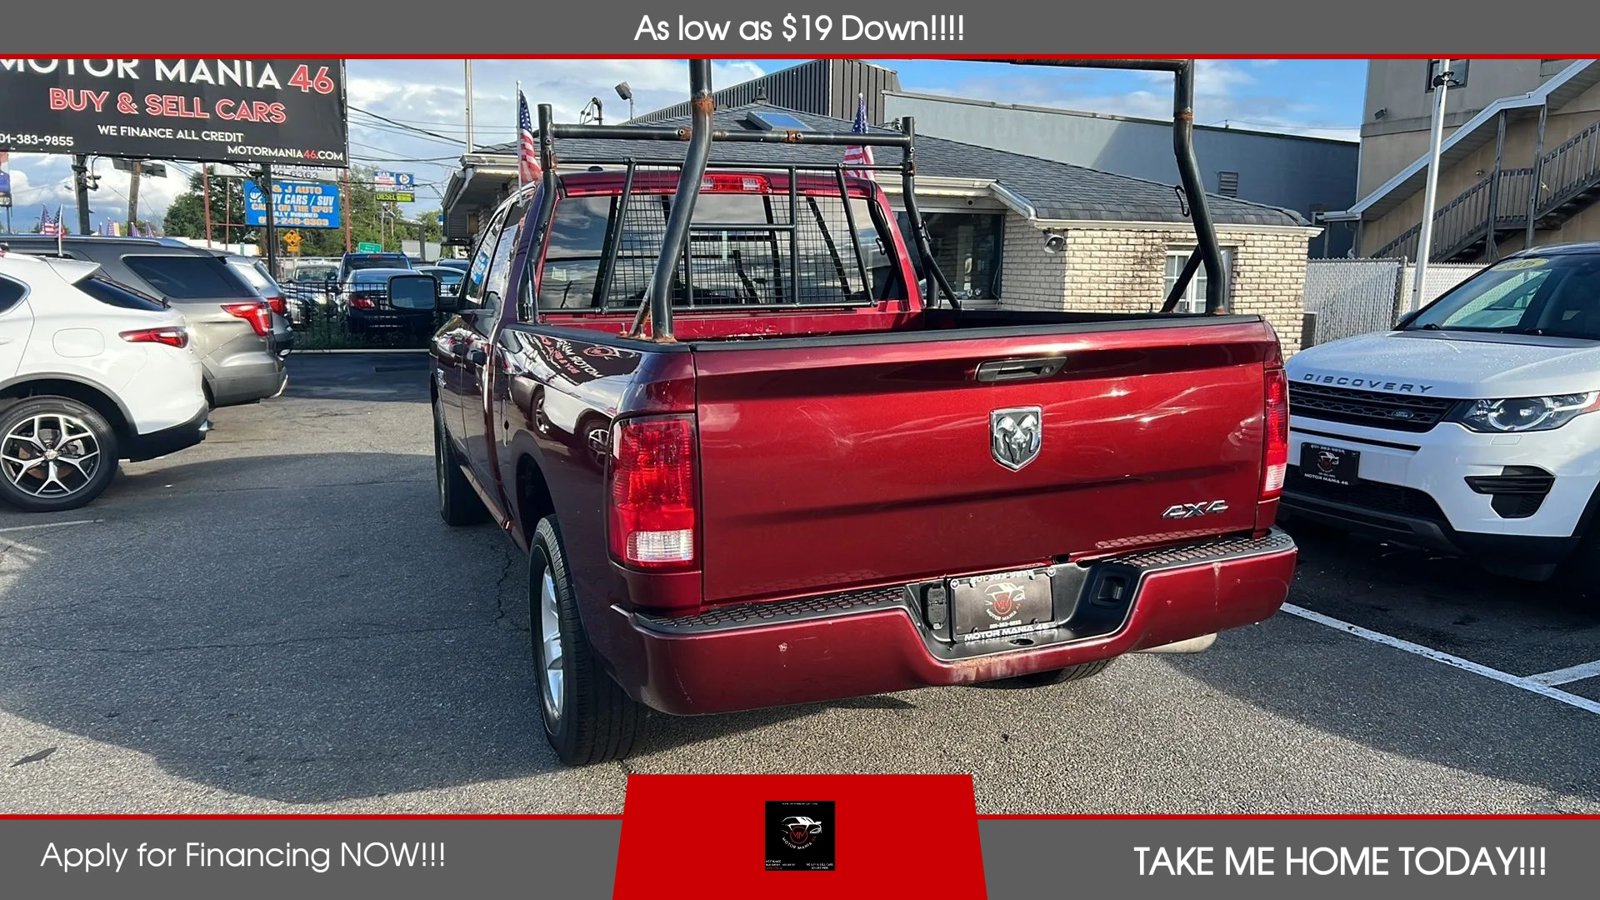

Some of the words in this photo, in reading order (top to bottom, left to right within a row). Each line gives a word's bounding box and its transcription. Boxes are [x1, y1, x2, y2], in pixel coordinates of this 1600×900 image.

[155, 59, 282, 90] MANIA
[287, 64, 335, 95] 46
[49, 87, 110, 113] BUY
[116, 91, 140, 115] &
[144, 93, 210, 119] SELL
[215, 98, 287, 124] CARS
[0, 132, 75, 147] 01-383-9855
[97, 124, 118, 136] WE
[120, 126, 174, 139] FINANCE
[176, 129, 200, 141] ALL
[201, 130, 245, 143] CREDIT
[227, 145, 344, 161] MOTORMANIA46.COM
[284, 194, 308, 206] CARS
[317, 195, 335, 207] SUV
[1303, 373, 1433, 394] DISCOVERY
[964, 630, 1000, 641] MOTOR
[1002, 624, 1034, 635] MANIA
